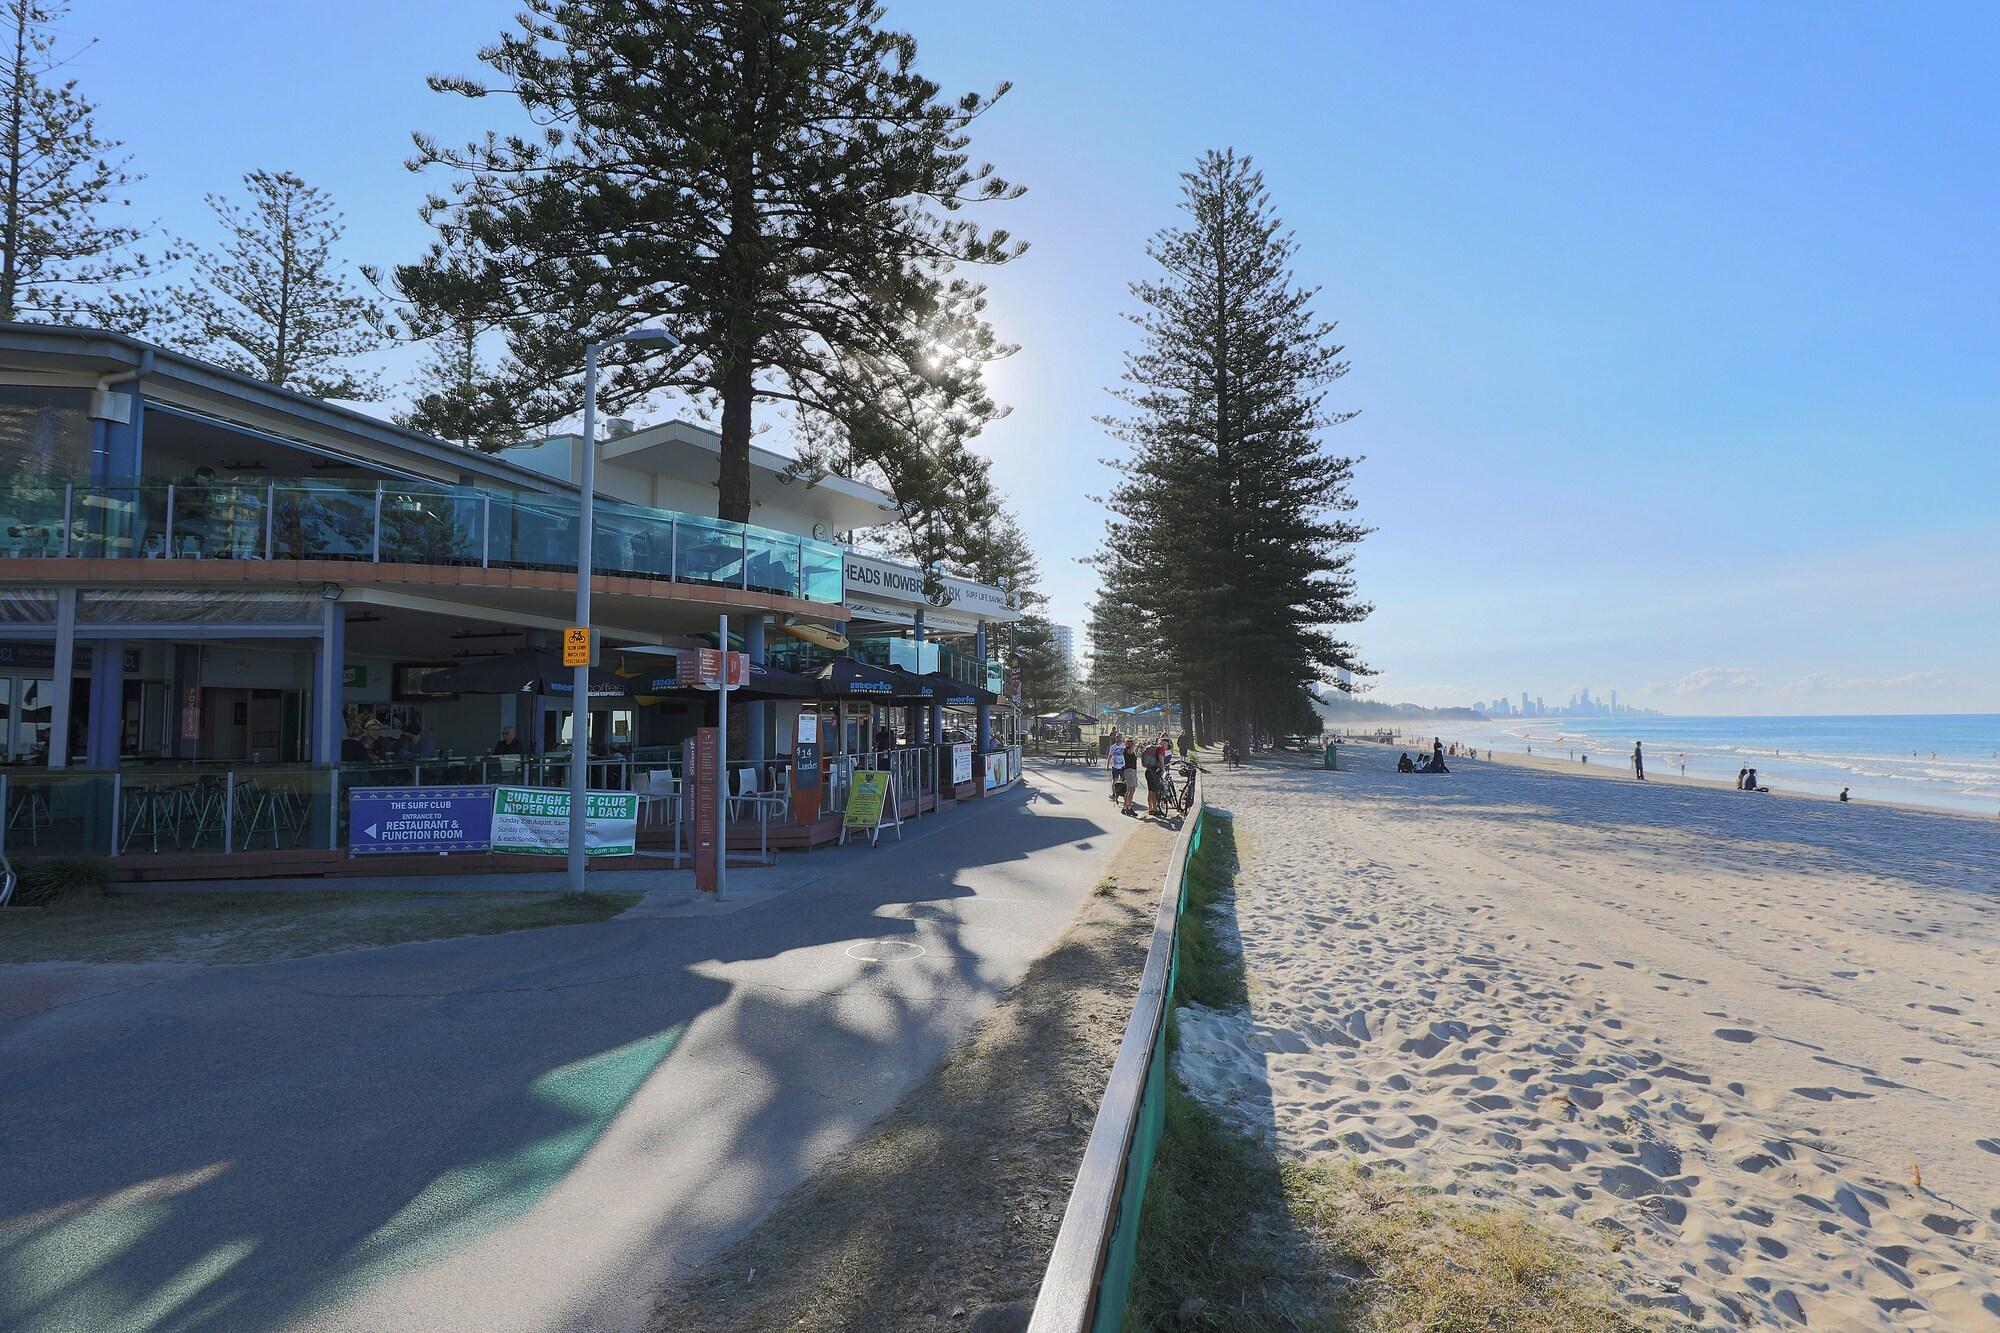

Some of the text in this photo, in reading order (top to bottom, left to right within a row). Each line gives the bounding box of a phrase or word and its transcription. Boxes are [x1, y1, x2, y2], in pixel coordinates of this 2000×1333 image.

[884, 571, 924, 594] MOWBR
[944, 584, 962, 602] ARK
[979, 592, 988, 601] LIFE
[850, 681, 893, 690] merlo
[507, 792, 563, 805] BURLEIGH
[597, 797, 627, 807] CLUB
[503, 803, 544, 815] NIPPER
[598, 807, 627, 817] DAYS
[386, 820, 459, 830] RESTAURANT &
[382, 830, 463, 840] FUNCTION ROOM
